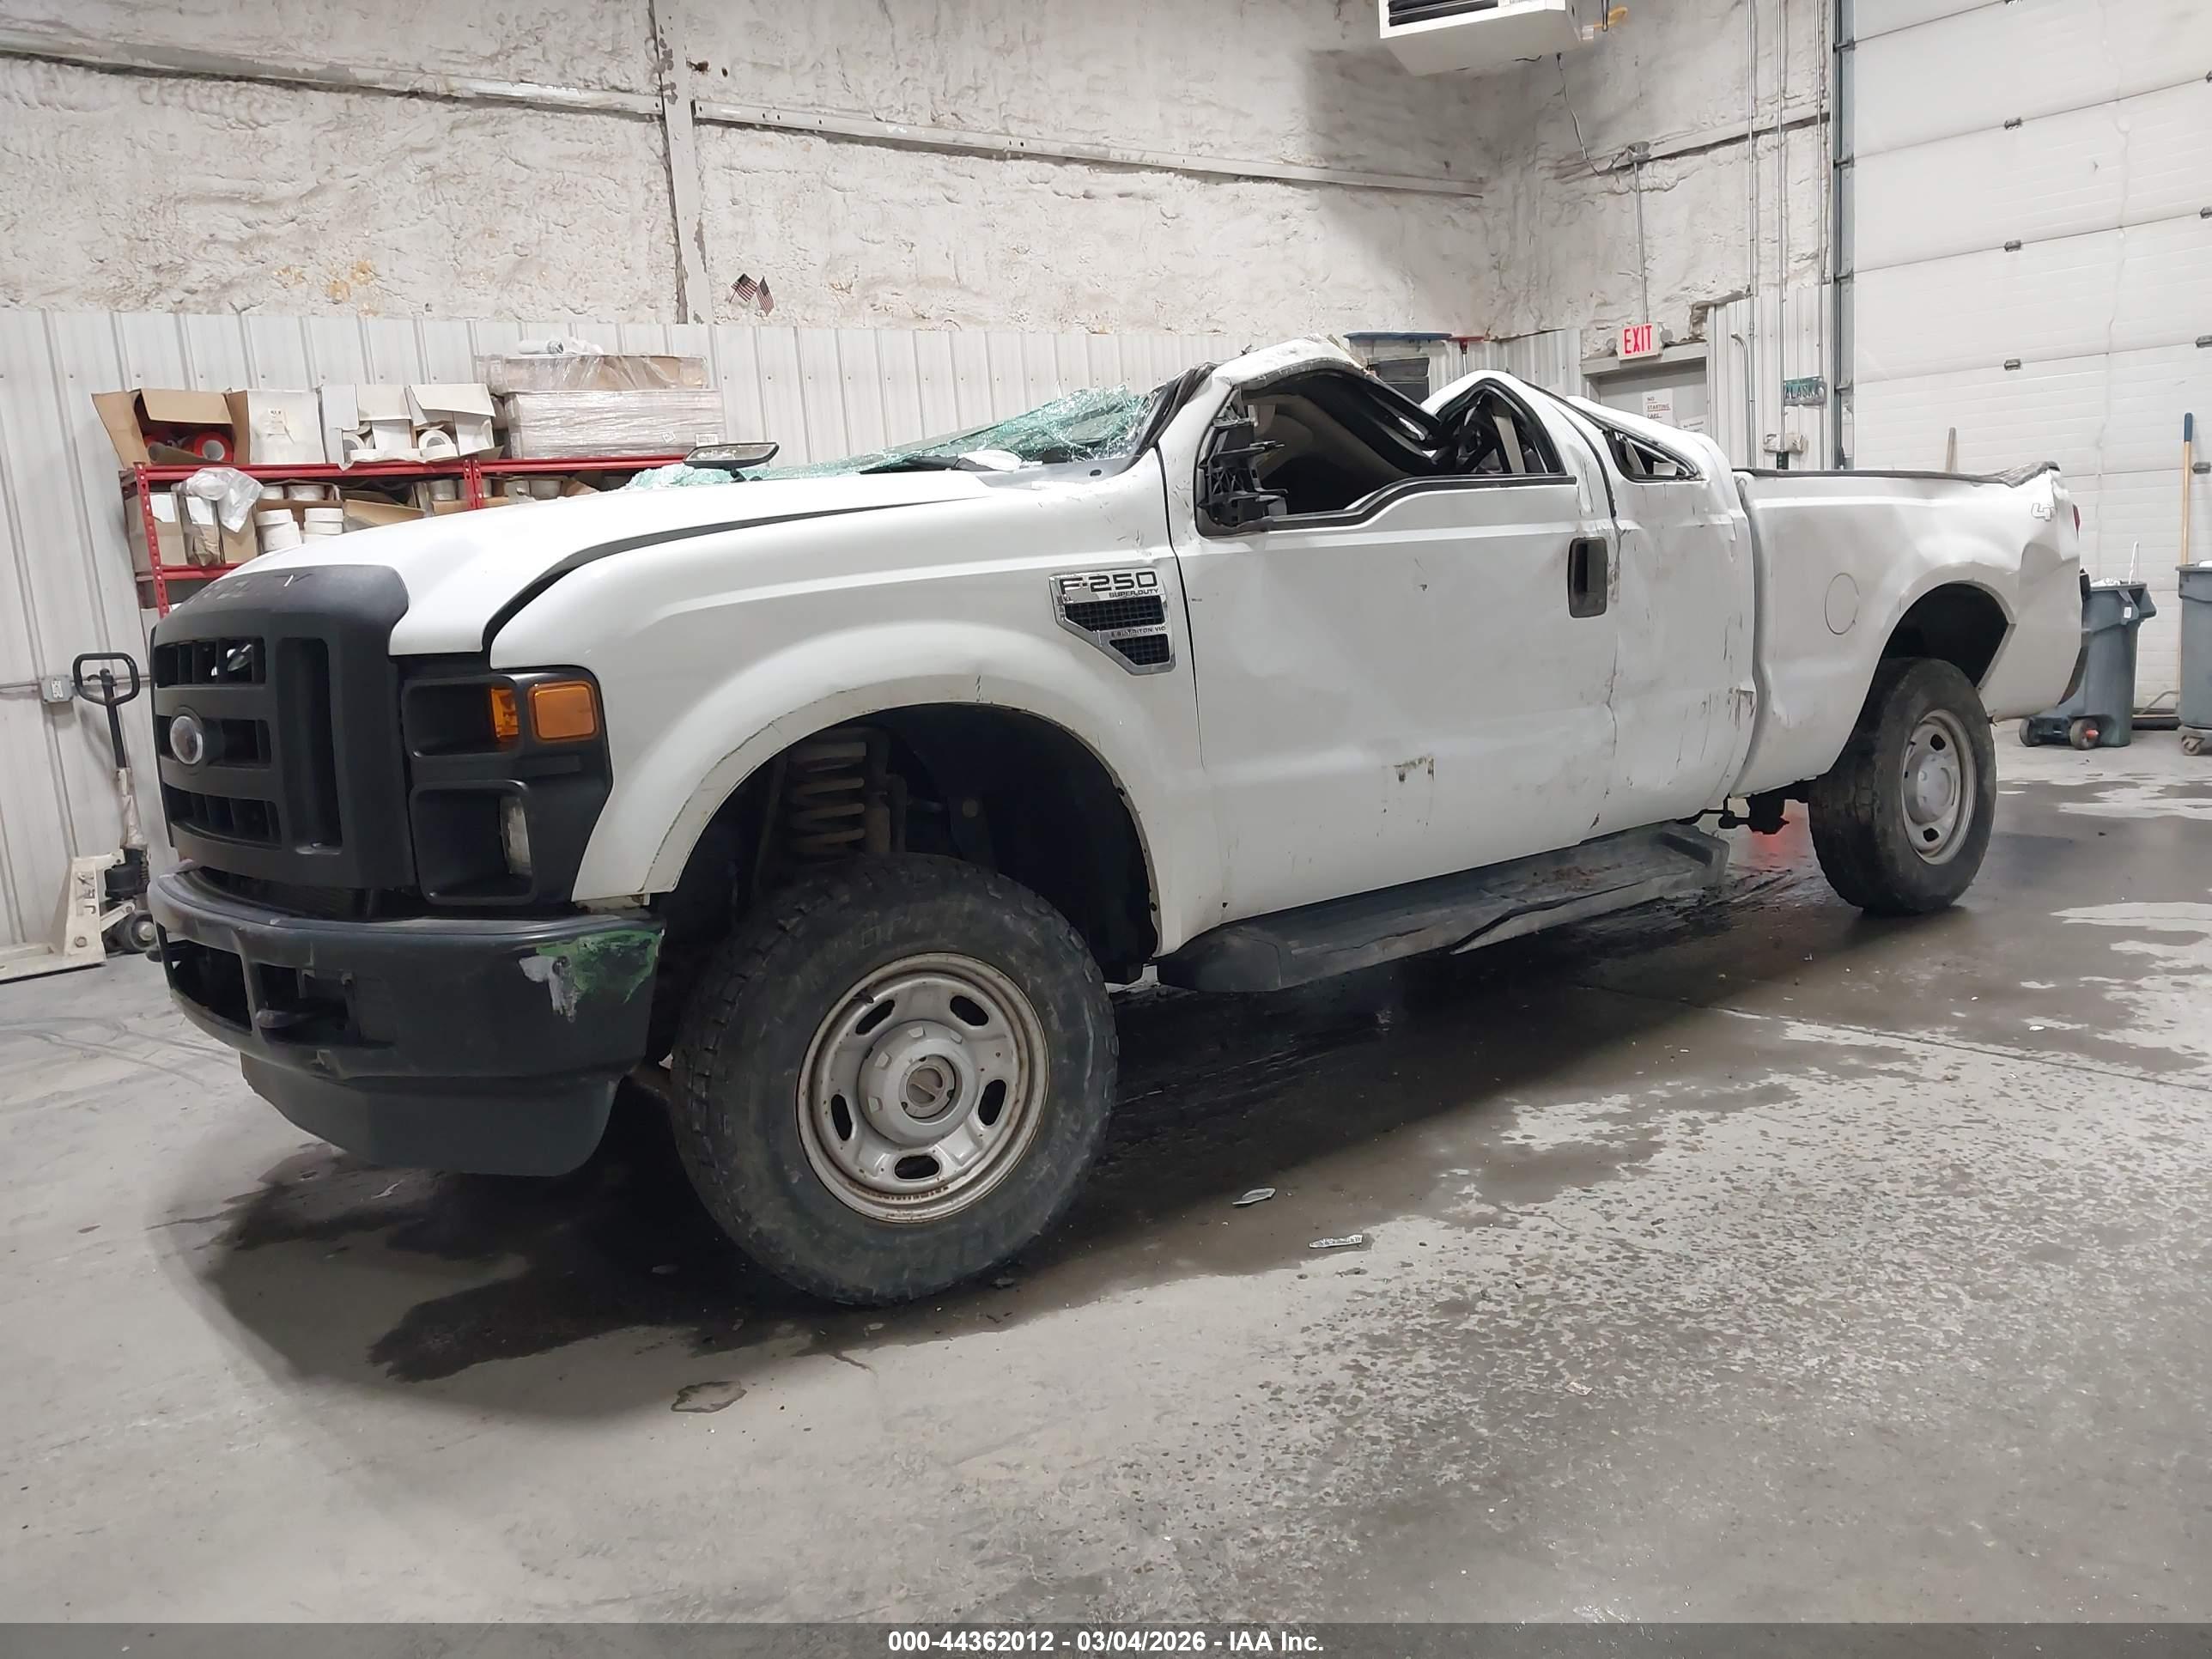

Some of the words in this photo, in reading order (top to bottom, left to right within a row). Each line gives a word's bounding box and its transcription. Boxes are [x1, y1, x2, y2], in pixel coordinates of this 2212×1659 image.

[1624, 325, 1652, 355] EXIT
[1785, 384, 1820, 399] ALASKA
[1059, 570, 1158, 595] F-250
[1109, 590, 1136, 599] SUPER
